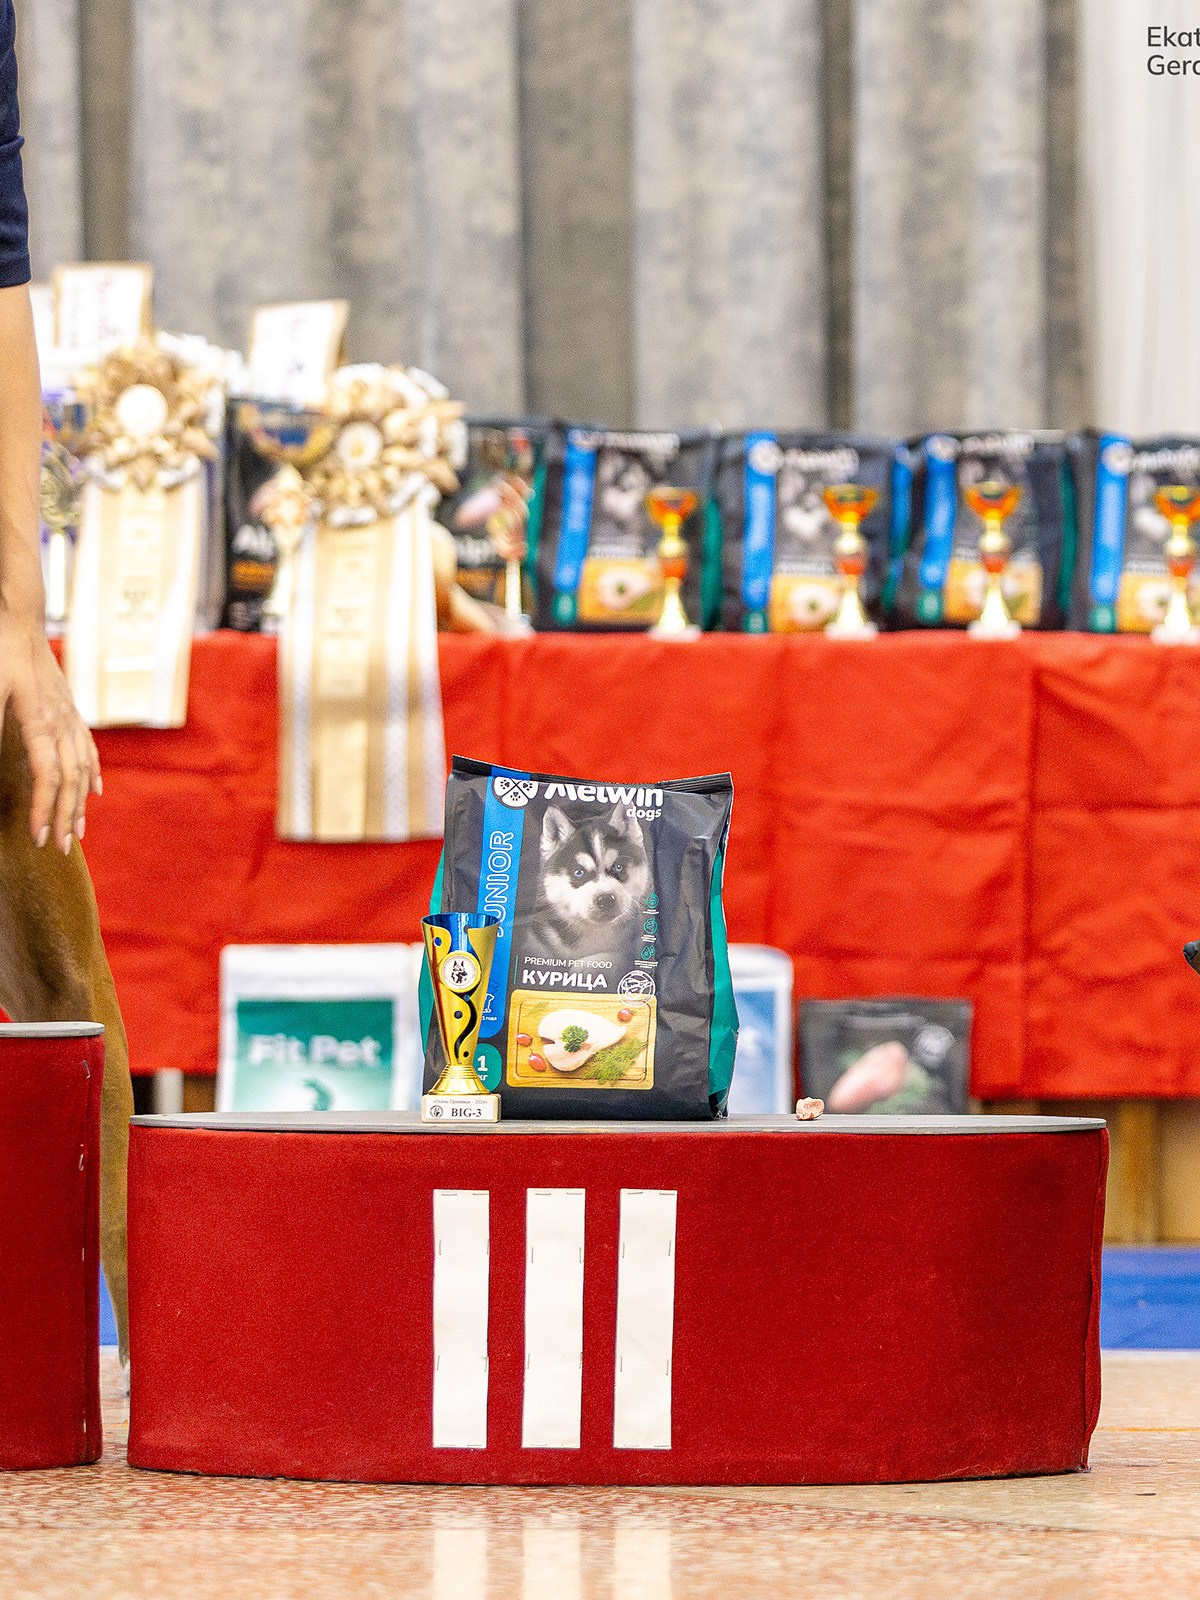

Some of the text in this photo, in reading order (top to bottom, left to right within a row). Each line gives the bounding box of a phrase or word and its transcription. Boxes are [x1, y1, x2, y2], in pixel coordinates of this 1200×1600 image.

[544, 783, 664, 808] Melwin
[626, 806, 662, 821] dogs
[483, 830, 515, 938] UNIOR
[524, 956, 613, 969] PREMIUM PET FOOD
[522, 969, 608, 991] КУРИЦА
[250, 1033, 381, 1067] Fit Pet
[477, 1055, 488, 1072] 1
[451, 1108, 482, 1118] BIG-3
